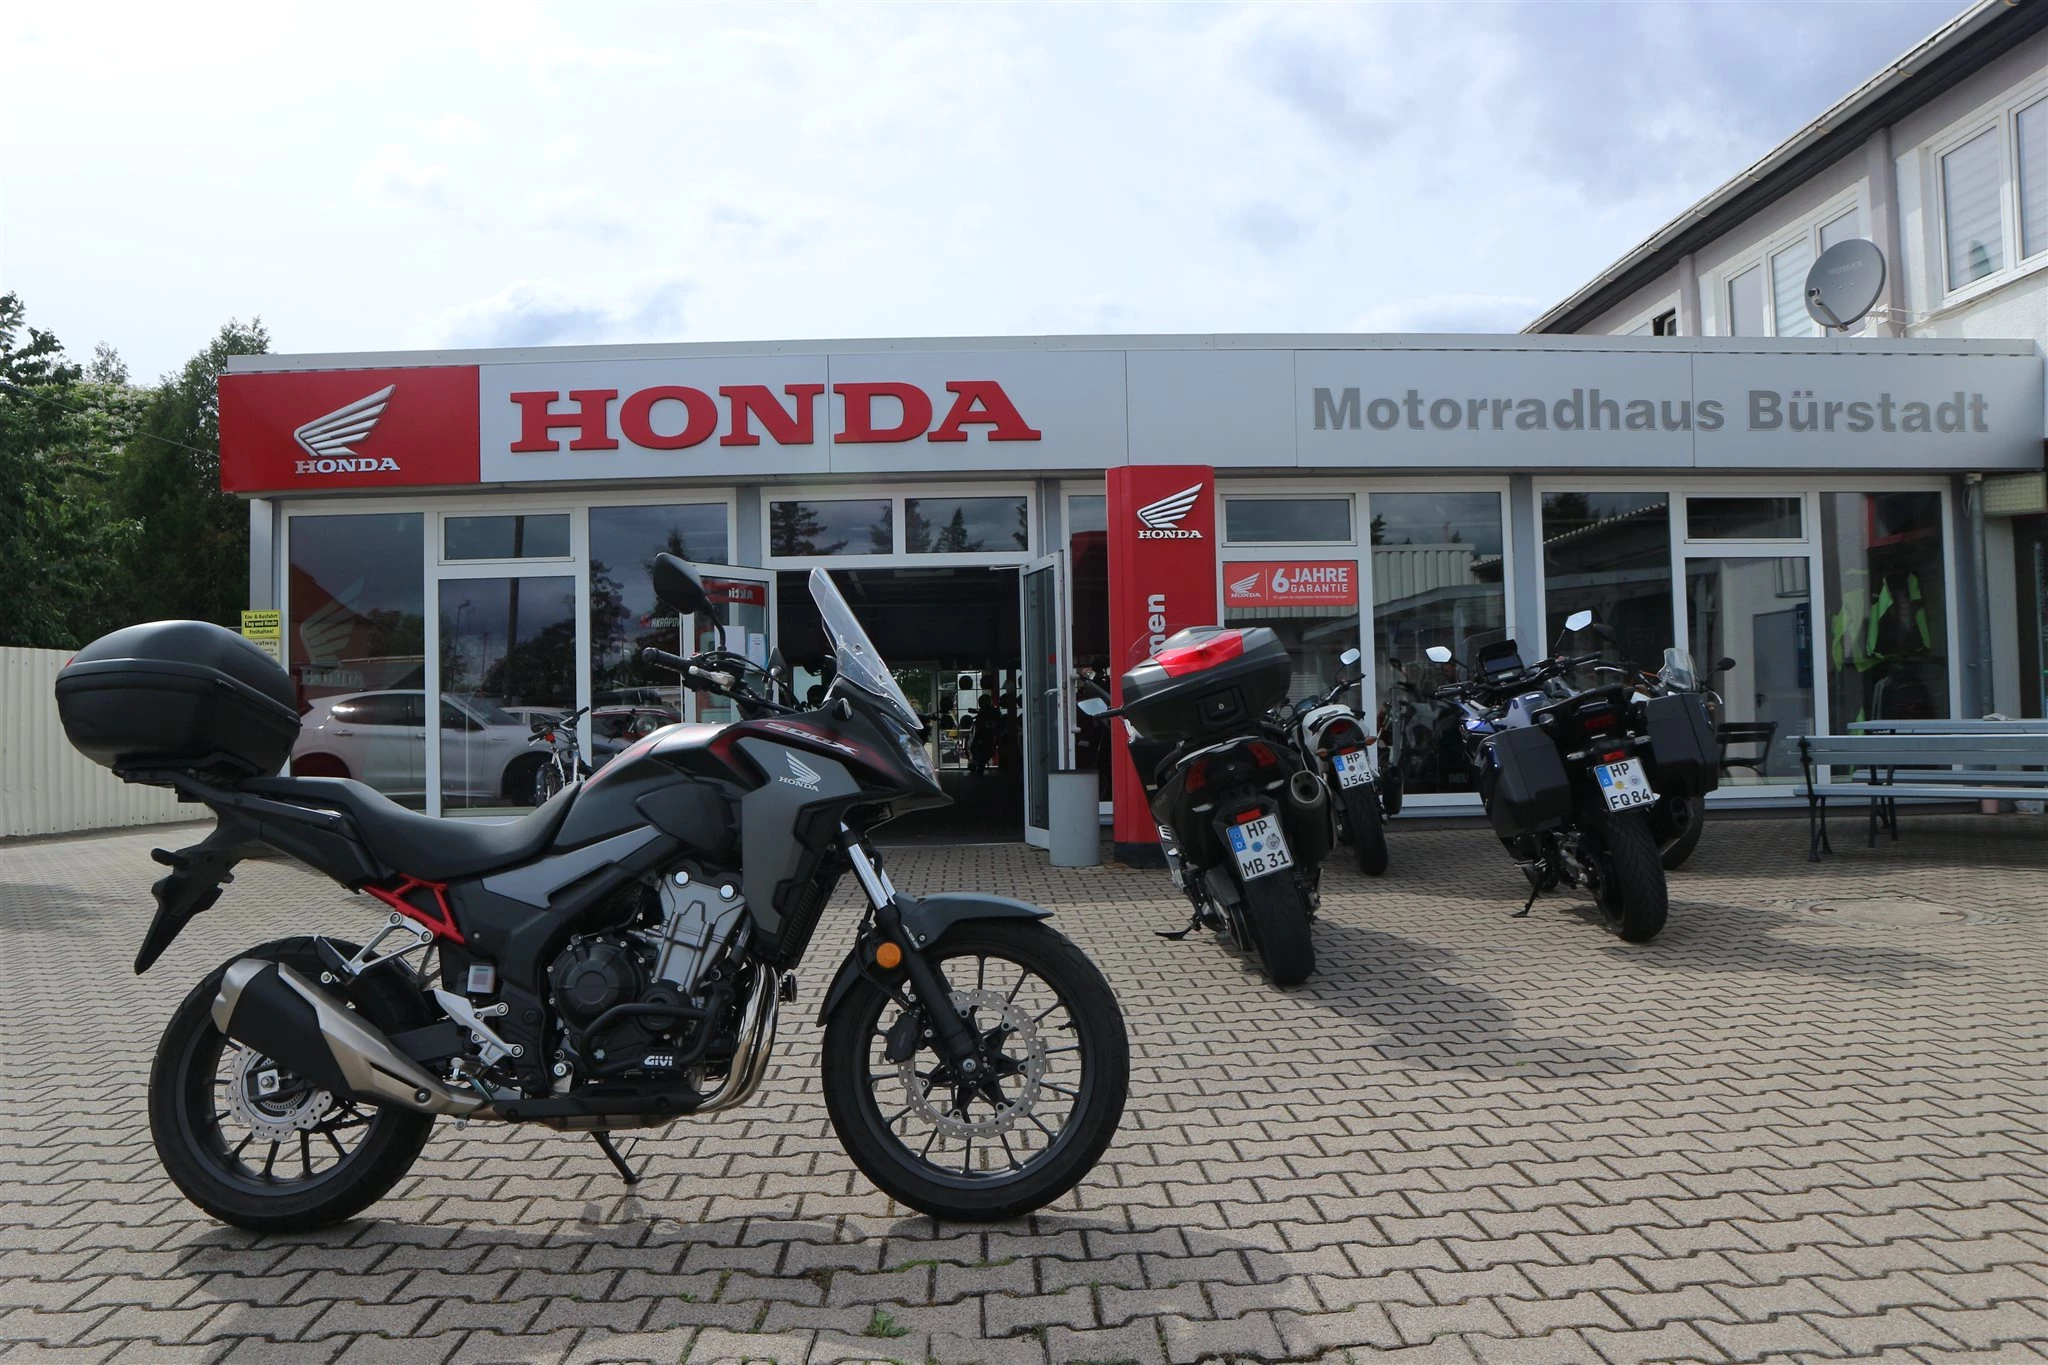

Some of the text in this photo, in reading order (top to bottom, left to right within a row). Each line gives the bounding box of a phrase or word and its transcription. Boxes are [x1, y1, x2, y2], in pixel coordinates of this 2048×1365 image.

[511, 381, 1041, 452] HONDA
[1312, 387, 1989, 432] Motorradhaus Bürstadt
[295, 457, 401, 474] HONDA
[1138, 529, 1203, 539] HONDA
[1271, 567, 1290, 594] 6
[1290, 583, 1348, 593] GARANTIE
[1148, 593, 1166, 657] men
[1346, 752, 1360, 764] HP
[1609, 762, 1630, 778] HP
[779, 776, 820, 792] HONDA
[1246, 819, 1268, 839] HP
[644, 1055, 673, 1067] GIVI
